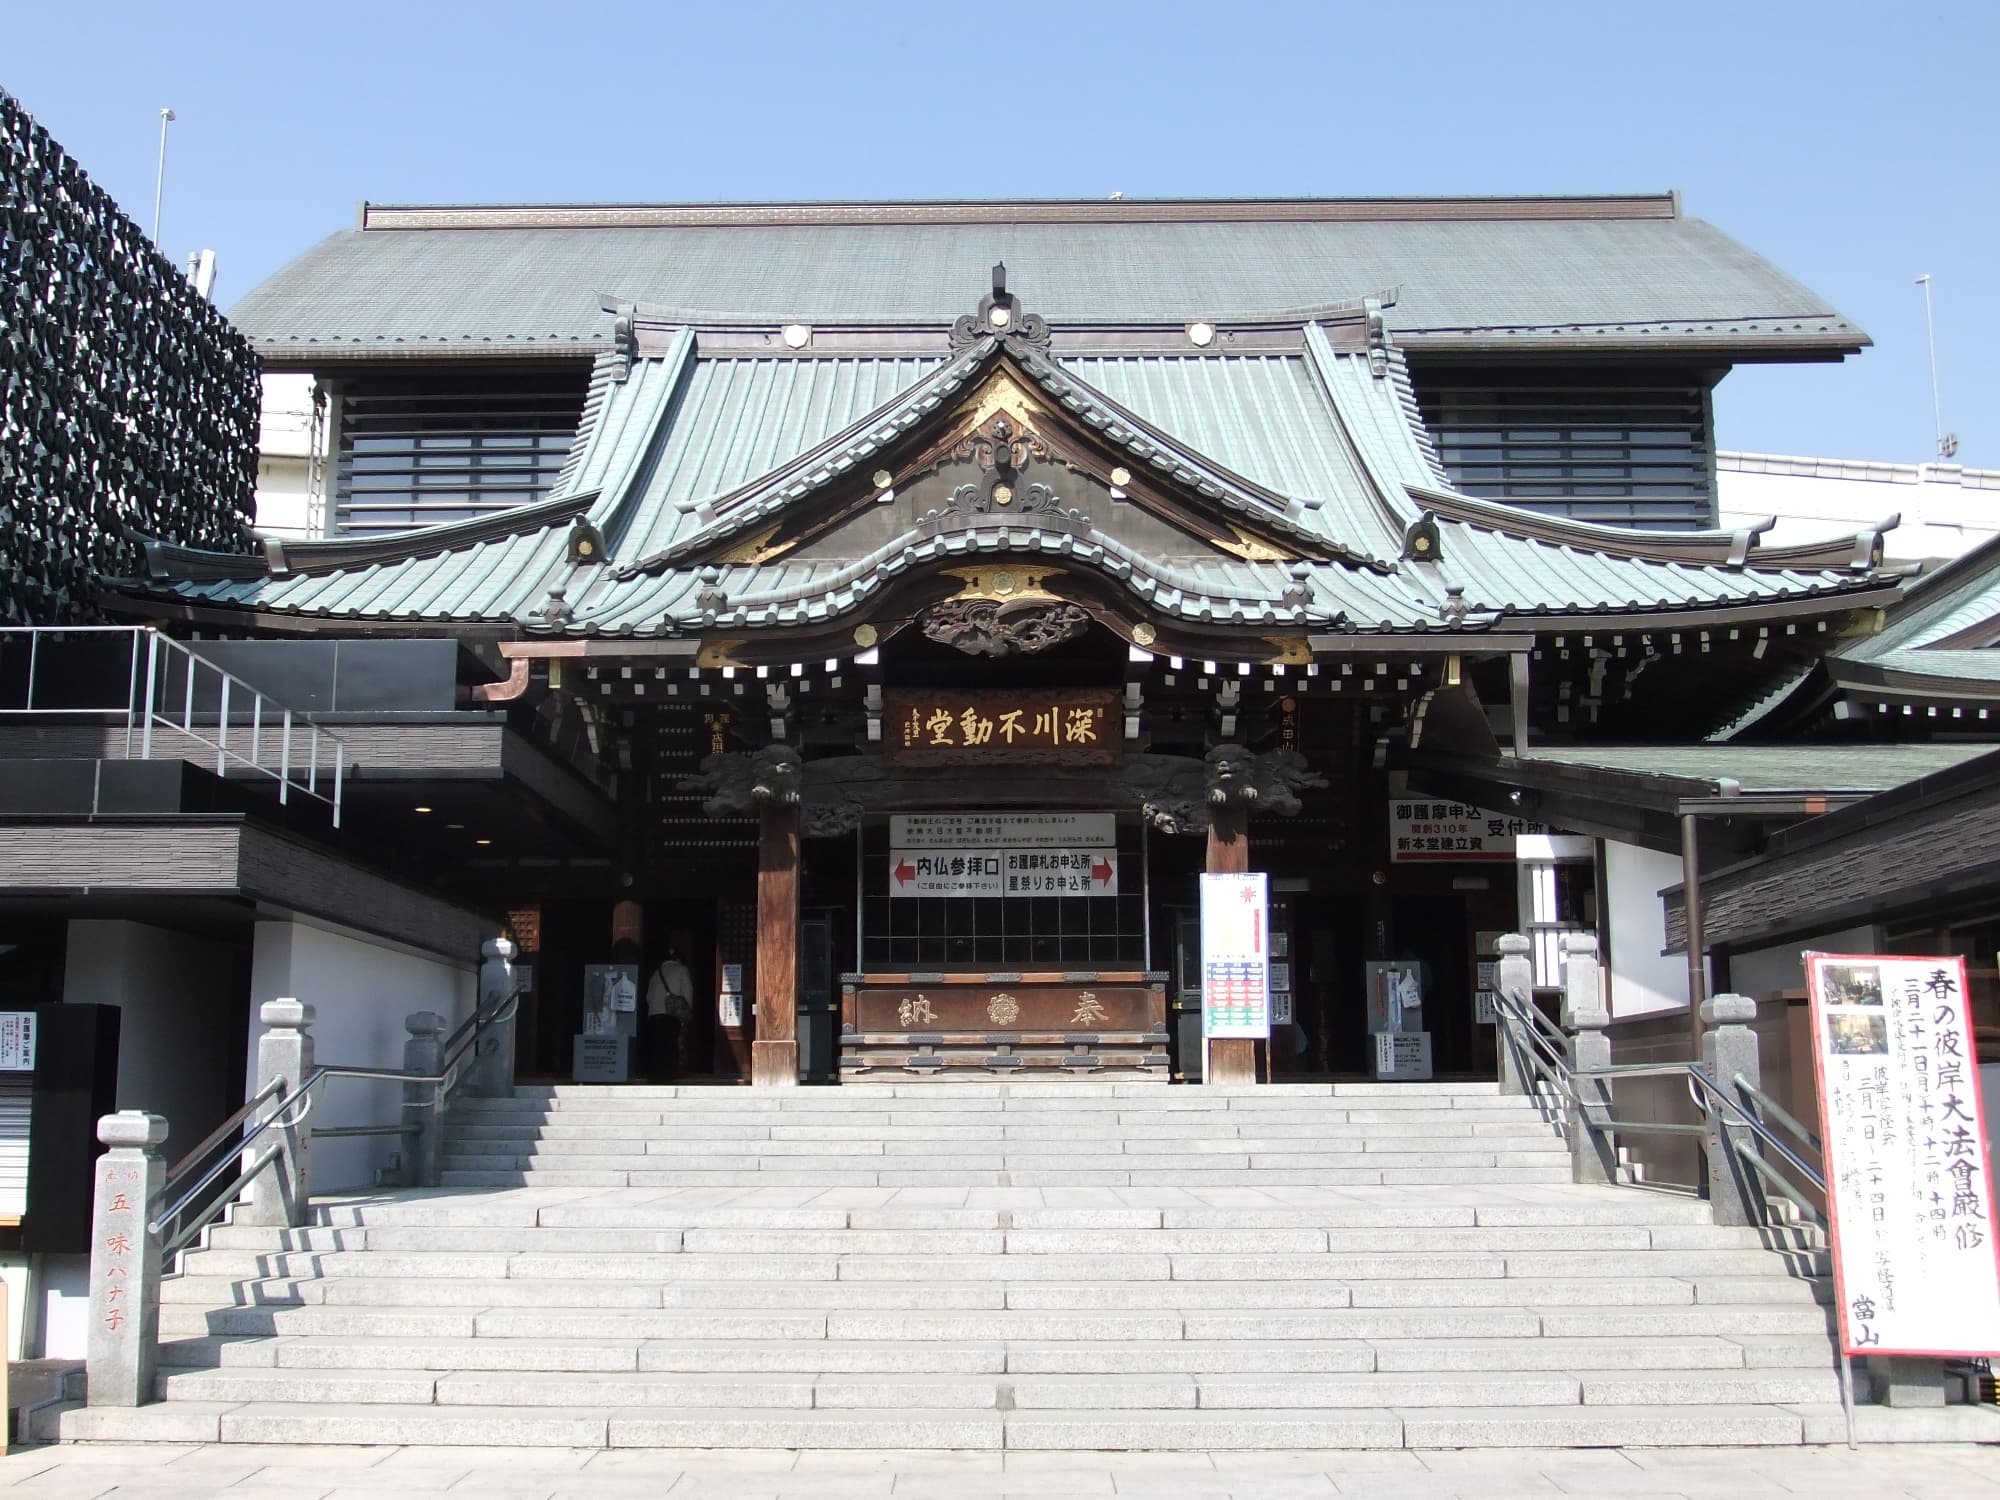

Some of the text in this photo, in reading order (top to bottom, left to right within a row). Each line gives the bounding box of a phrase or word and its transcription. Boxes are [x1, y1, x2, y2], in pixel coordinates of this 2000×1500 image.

[926, 706, 1097, 746] 深川不動堂
[1396, 804, 1482, 820] 御護摩申込
[1487, 819, 1544, 837] 受付所
[916, 857, 999, 876] 内仏参拝口
[1008, 854, 1091, 870] お護摩札お申込所
[1008, 876, 1091, 891] 星祭りお申込所
